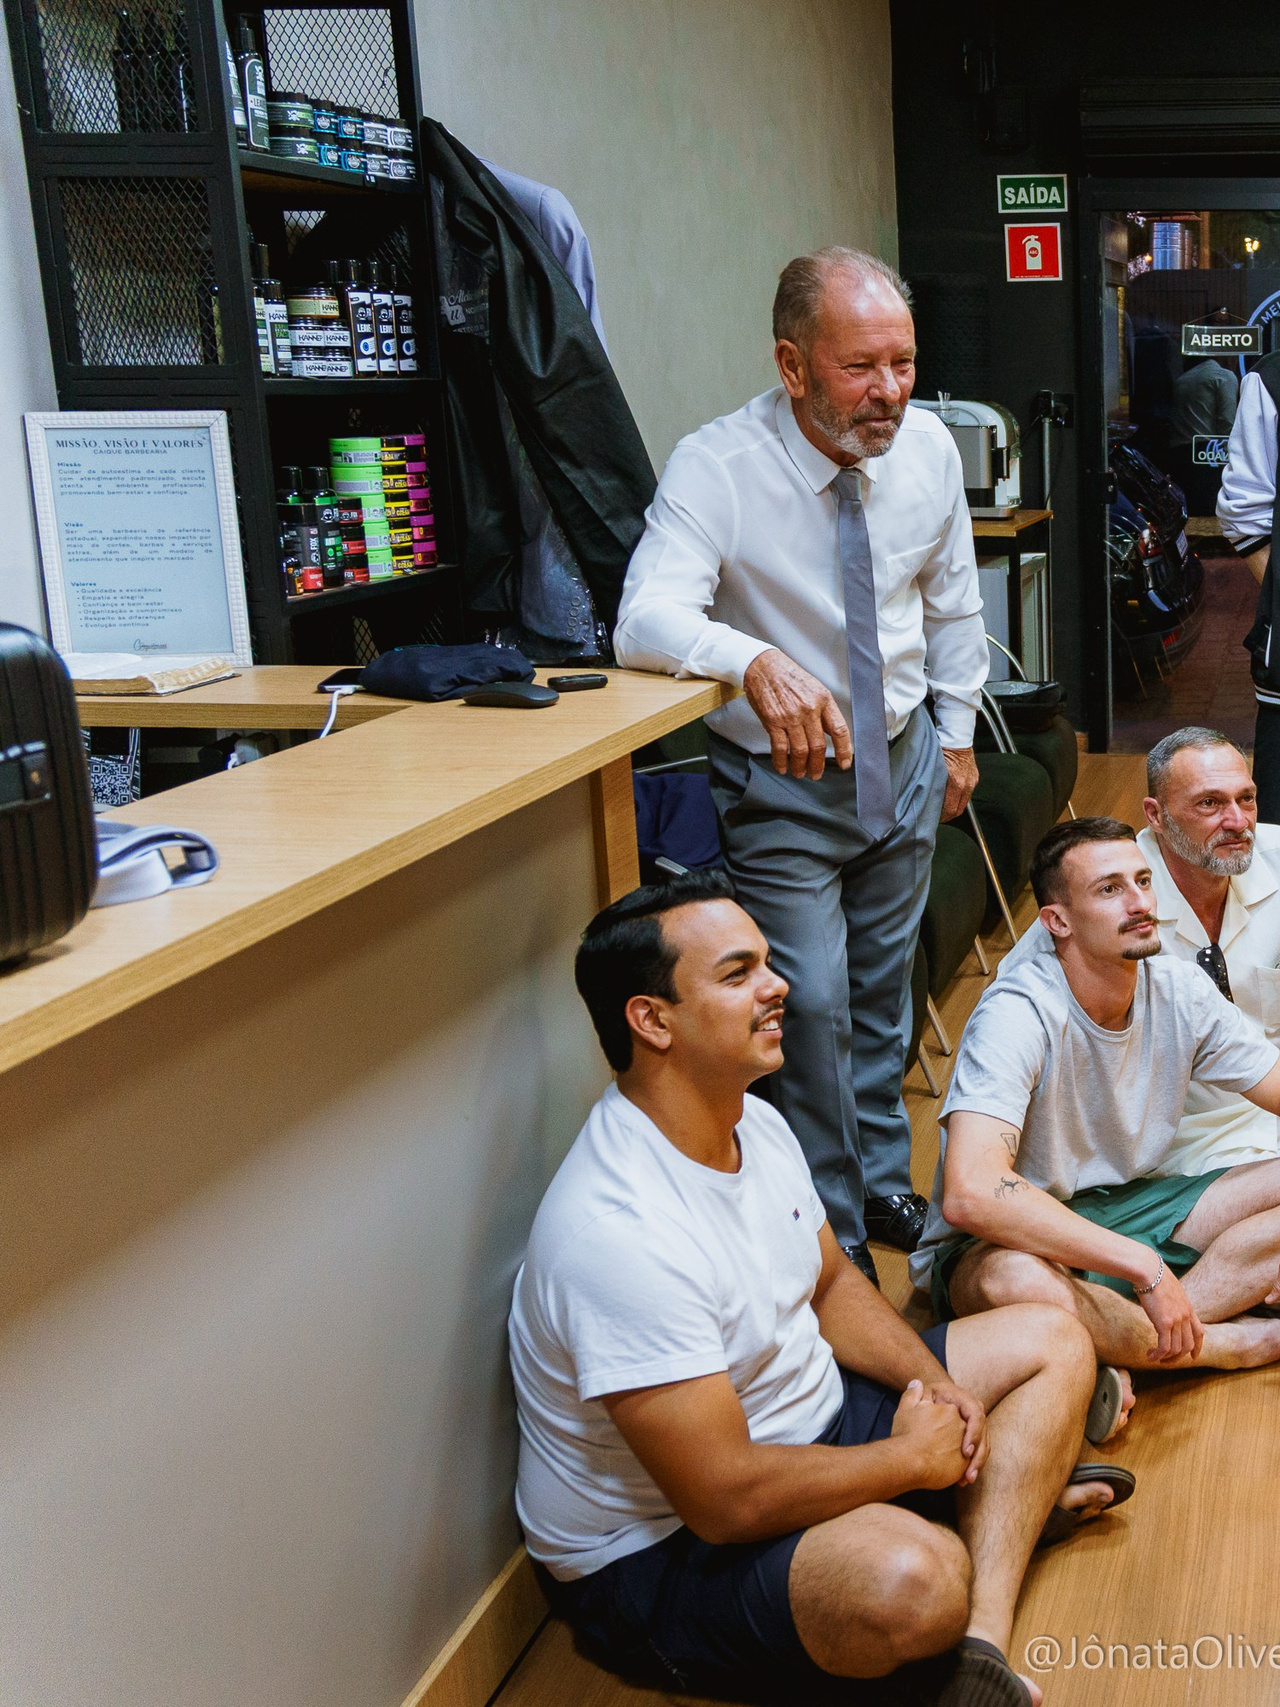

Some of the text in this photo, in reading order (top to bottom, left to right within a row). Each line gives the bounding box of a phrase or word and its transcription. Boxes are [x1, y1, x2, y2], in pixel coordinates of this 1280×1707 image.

[1004, 182, 1062, 205] SAÍDA
[1190, 334, 1253, 347] ABERTO
[56, 438, 100, 448] MISSÃO,
[104, 438, 138, 448] VISÃO
[152, 439, 204, 448] VALORES
